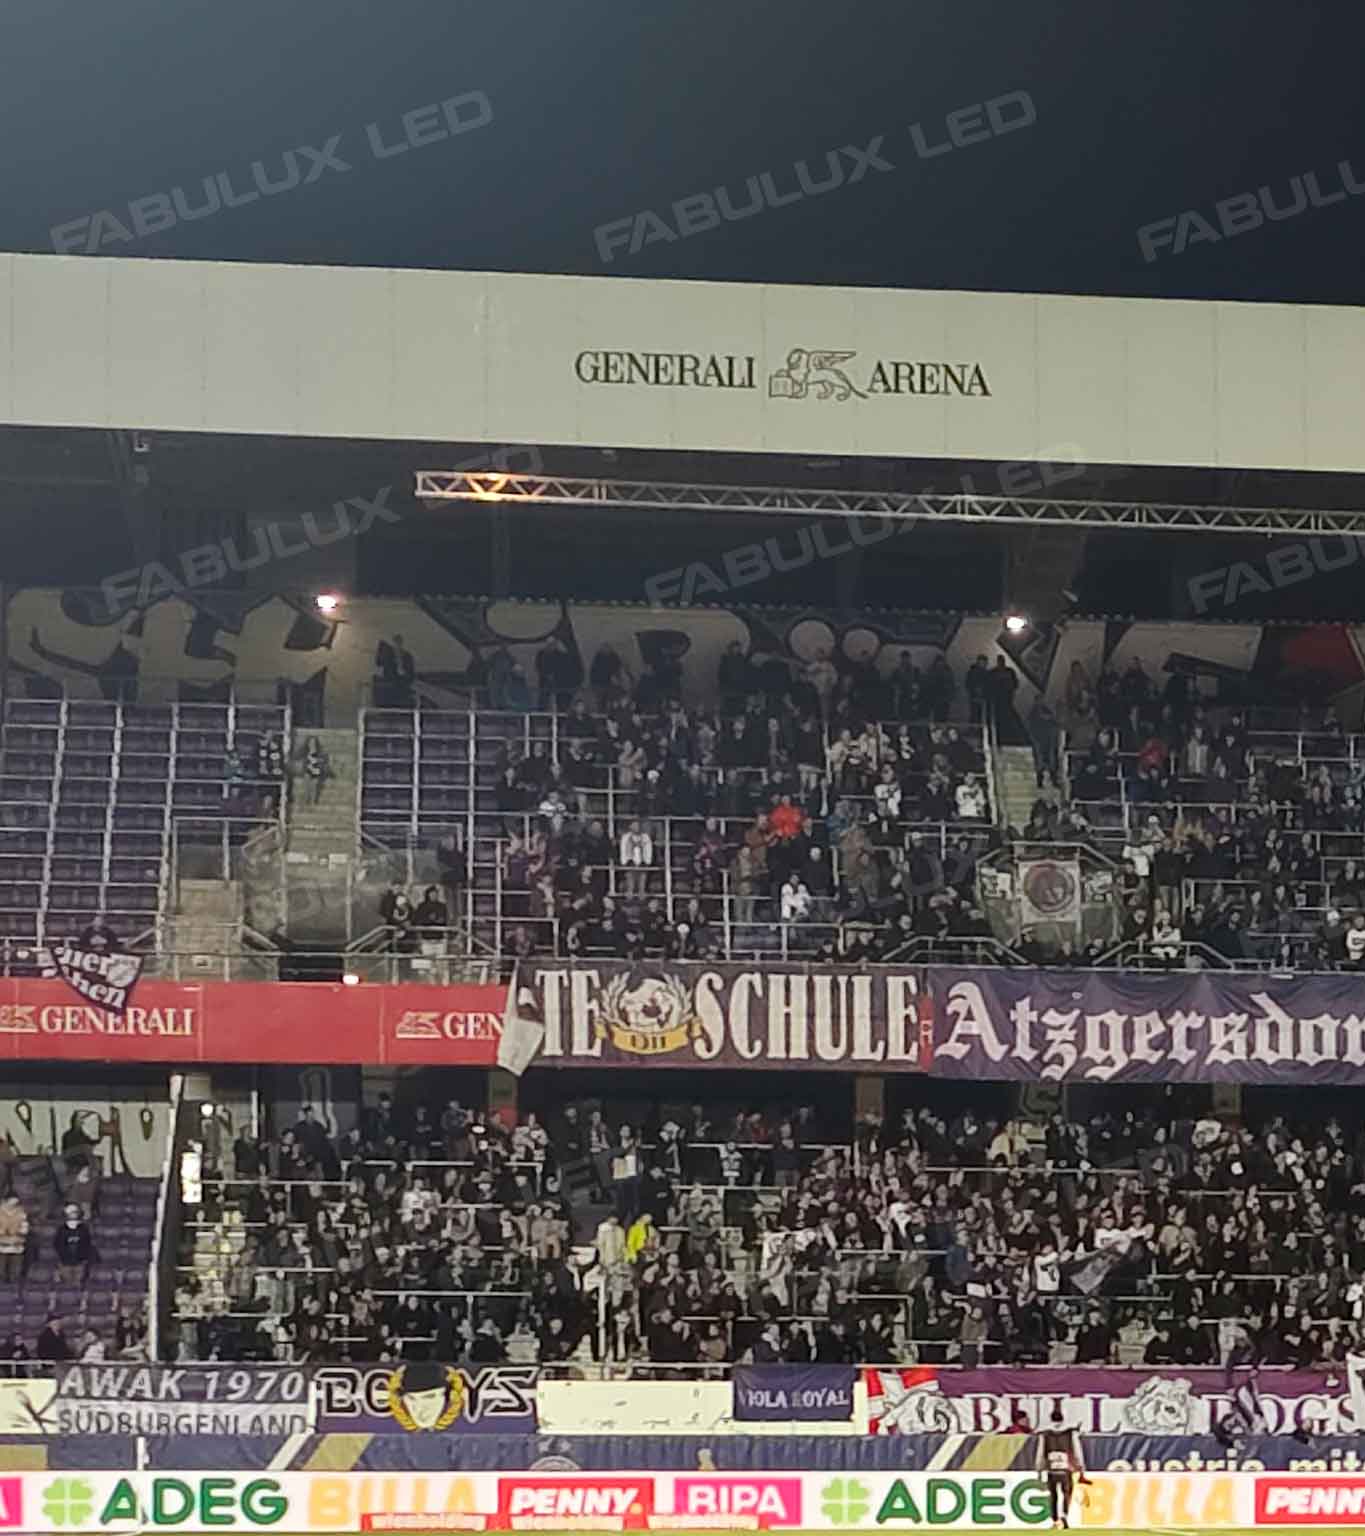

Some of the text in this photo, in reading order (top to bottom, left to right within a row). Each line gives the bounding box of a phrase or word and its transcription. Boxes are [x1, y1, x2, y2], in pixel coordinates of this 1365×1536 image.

[575, 351, 992, 397] GENERALI ARENA
[40, 1005, 193, 1036] GENERALI
[690, 972, 918, 1060] SCHULE
[60, 1366, 304, 1401] AWAK 1970
[101, 1478, 289, 1525] ADEG
[687, 1485, 787, 1519] BIPA
[876, 1478, 1050, 1524] ADEG
[1081, 1478, 1234, 1525] BILLA
